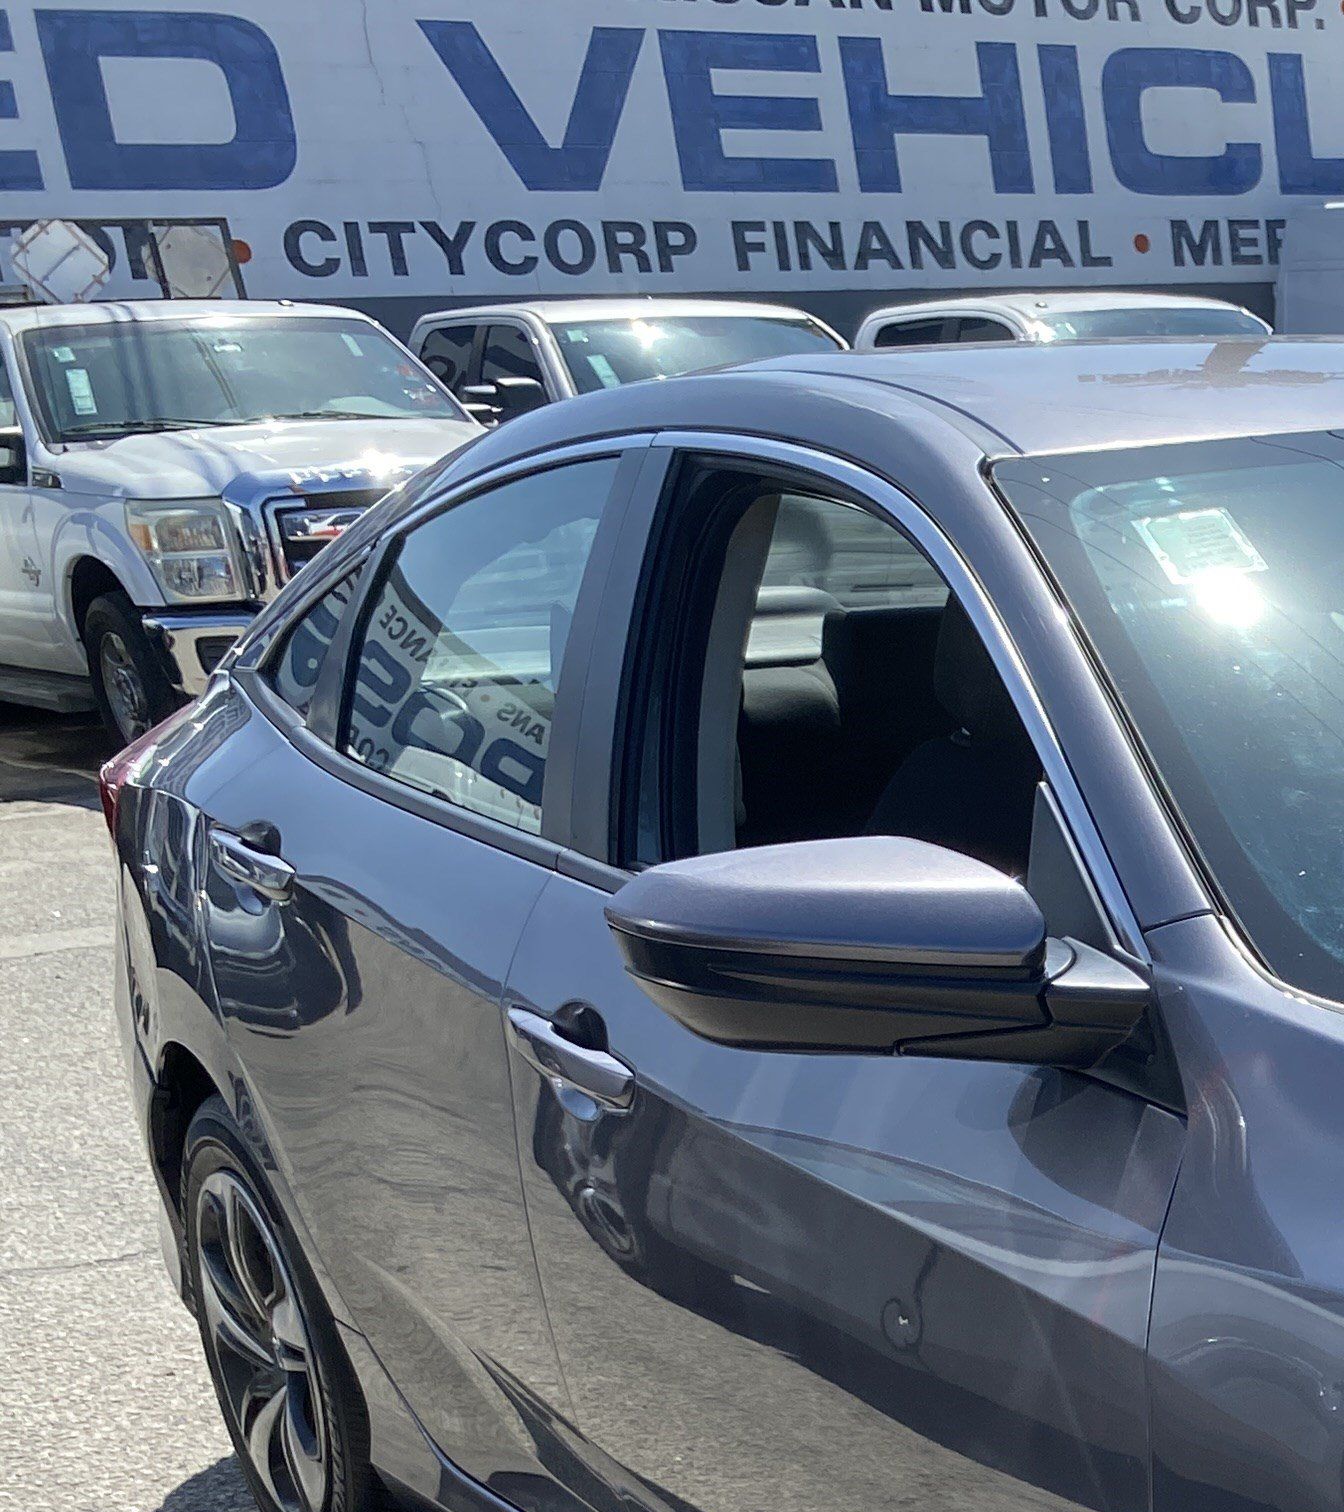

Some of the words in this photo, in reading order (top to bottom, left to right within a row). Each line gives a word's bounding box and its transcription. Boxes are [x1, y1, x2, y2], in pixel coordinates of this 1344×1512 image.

[0, 9, 298, 192] D
[284, 219, 698, 277] CITYCORP
[731, 219, 1113, 272] FINANCIAL
